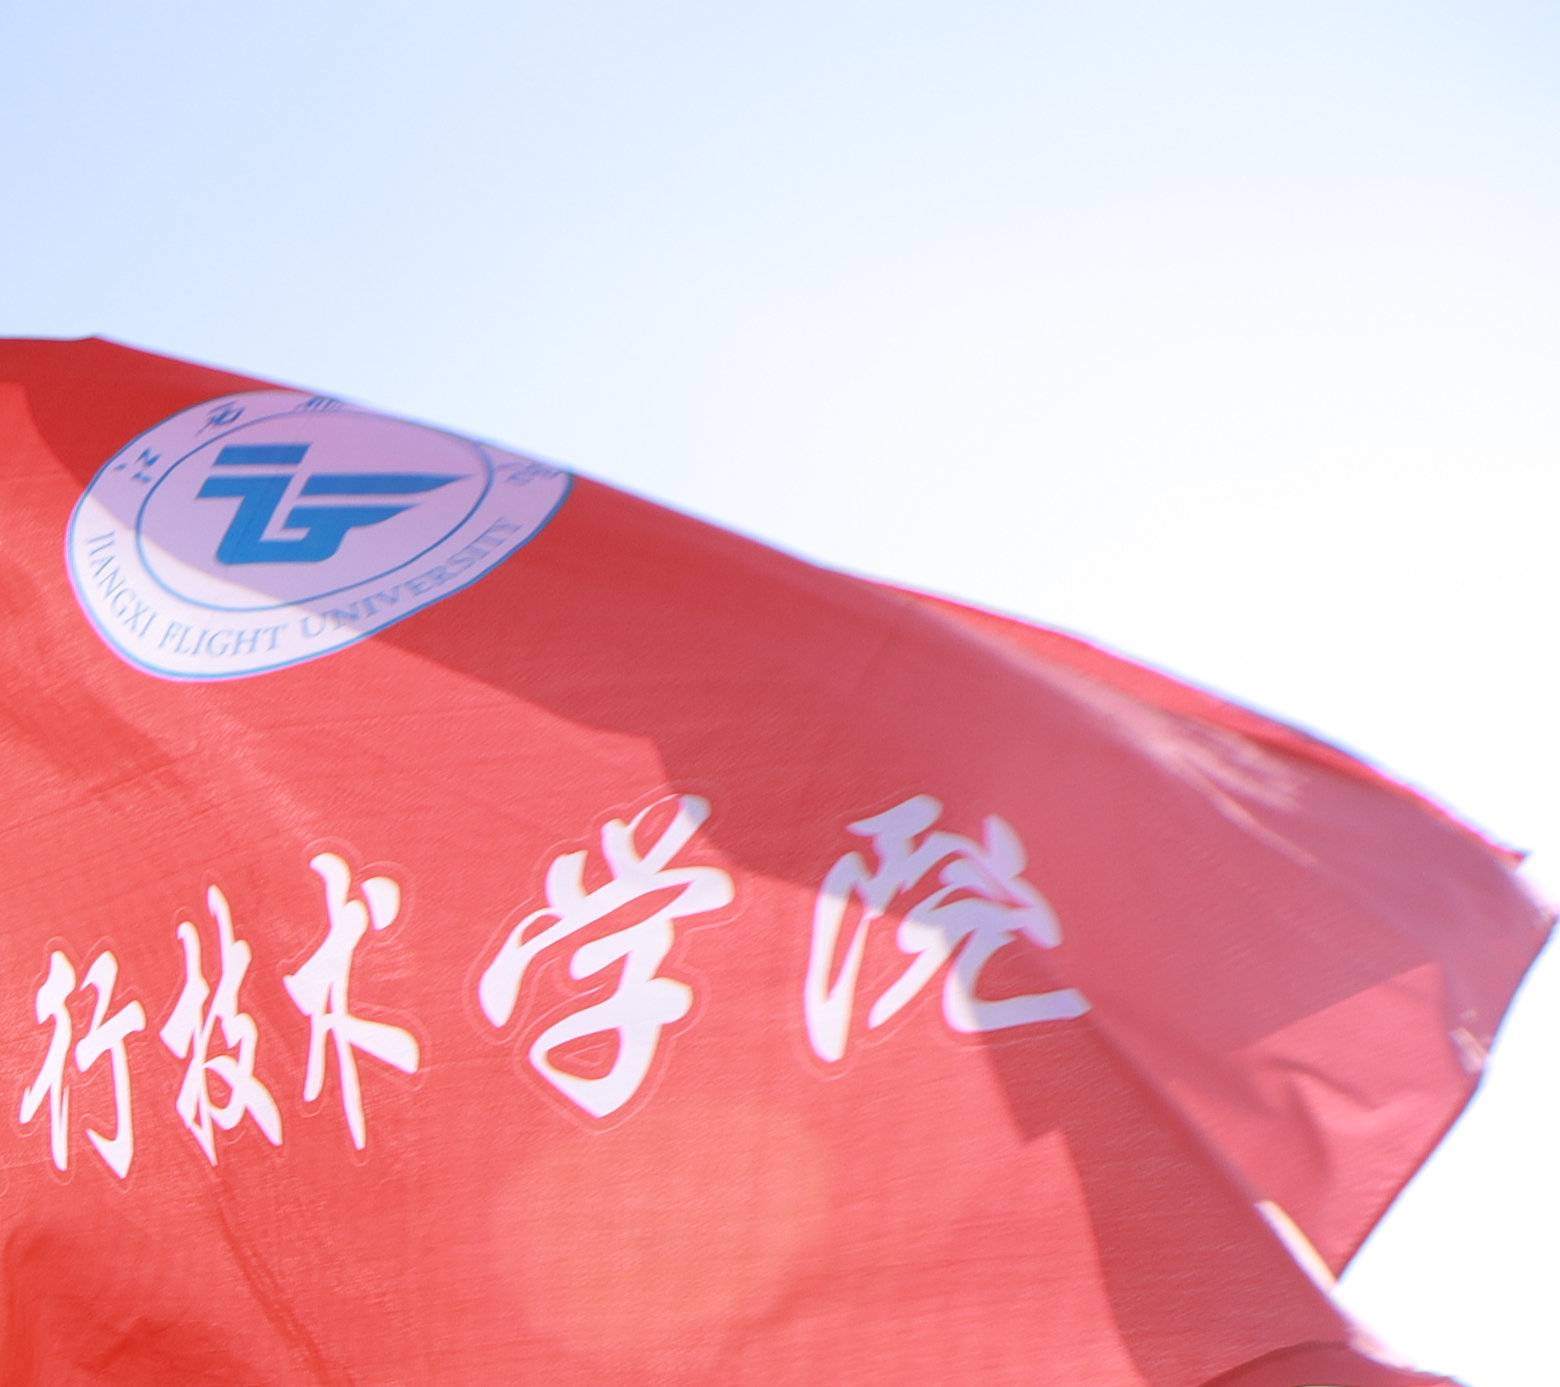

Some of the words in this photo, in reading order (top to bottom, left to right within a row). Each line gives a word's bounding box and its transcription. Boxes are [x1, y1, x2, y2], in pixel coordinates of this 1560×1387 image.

[86, 530, 157, 639] JIANGXI
[158, 622, 286, 659] FLIGHT
[300, 515, 523, 642] UNIVERSITY
